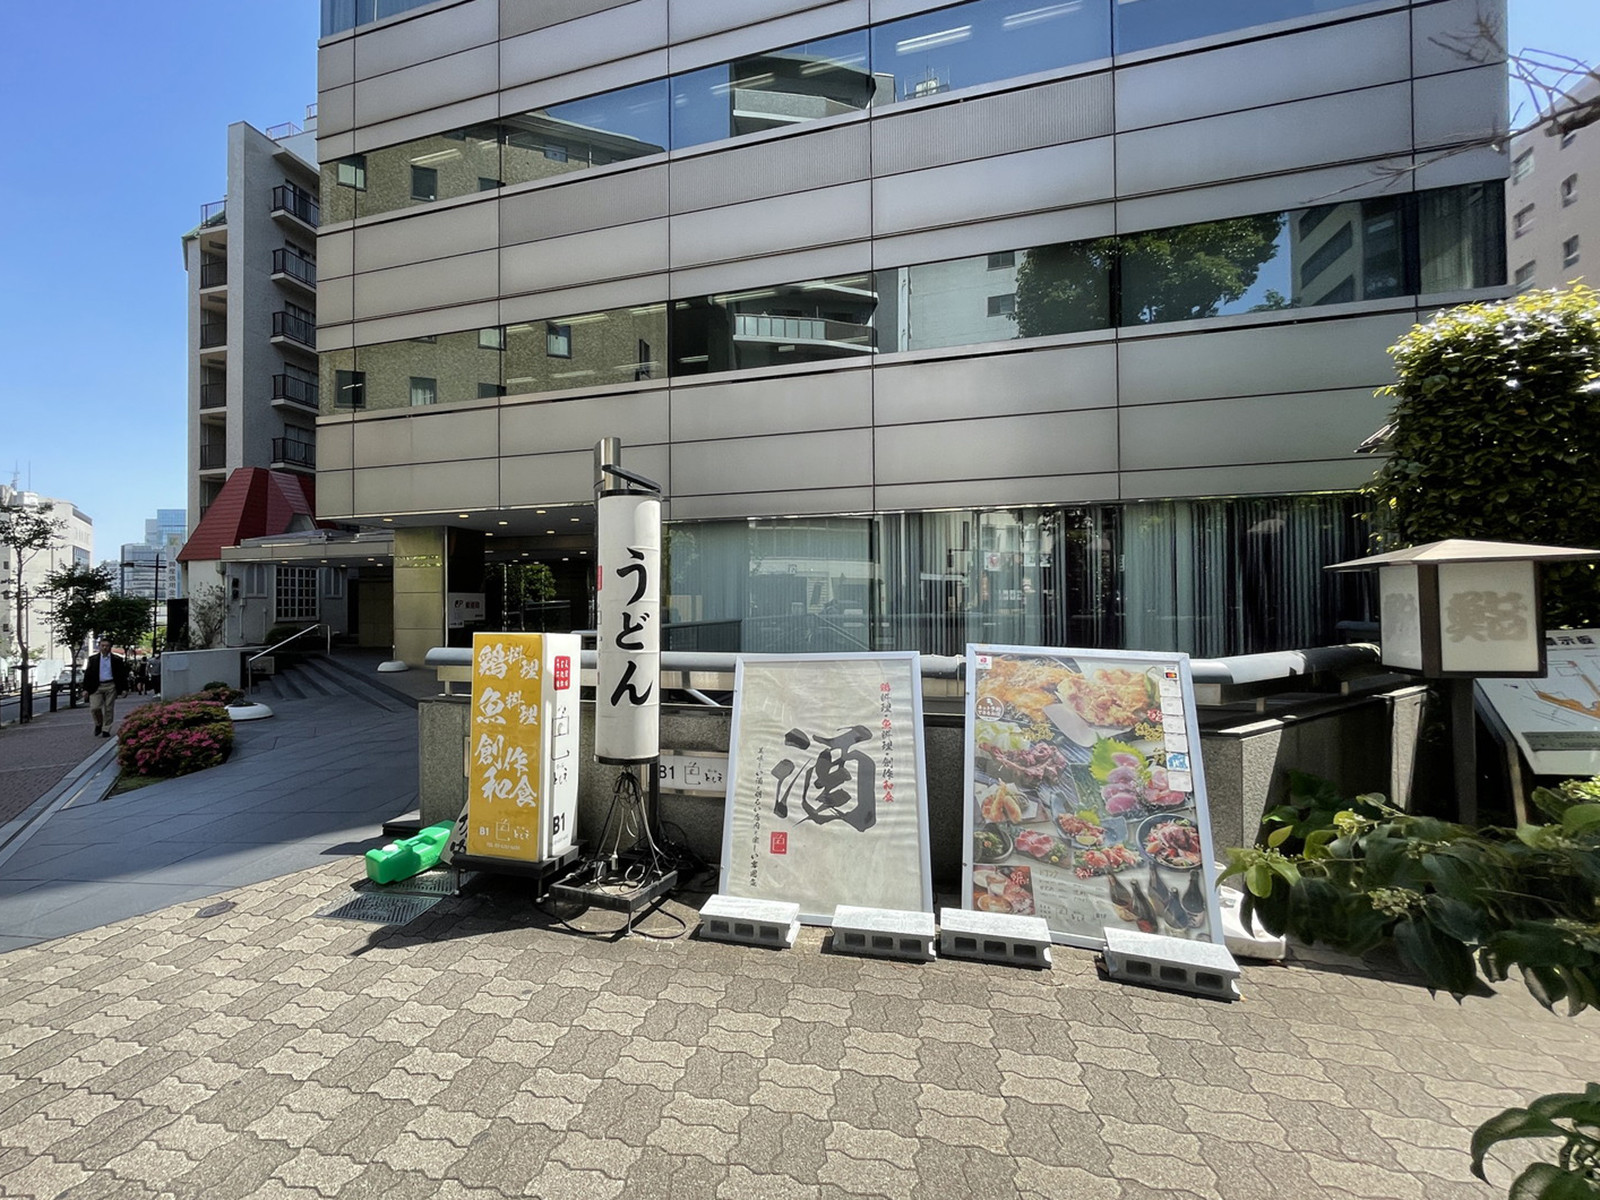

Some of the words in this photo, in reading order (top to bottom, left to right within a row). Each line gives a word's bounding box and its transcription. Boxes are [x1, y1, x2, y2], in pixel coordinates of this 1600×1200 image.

[610, 547, 654, 707] うどん
[478, 642, 539, 680] 鶏料理
[476, 687, 538, 725] 魚料理
[474, 733, 529, 777] 創作
[481, 766, 537, 807] 和食
[770, 724, 877, 833] 酒
[553, 812, 566, 835] B1
